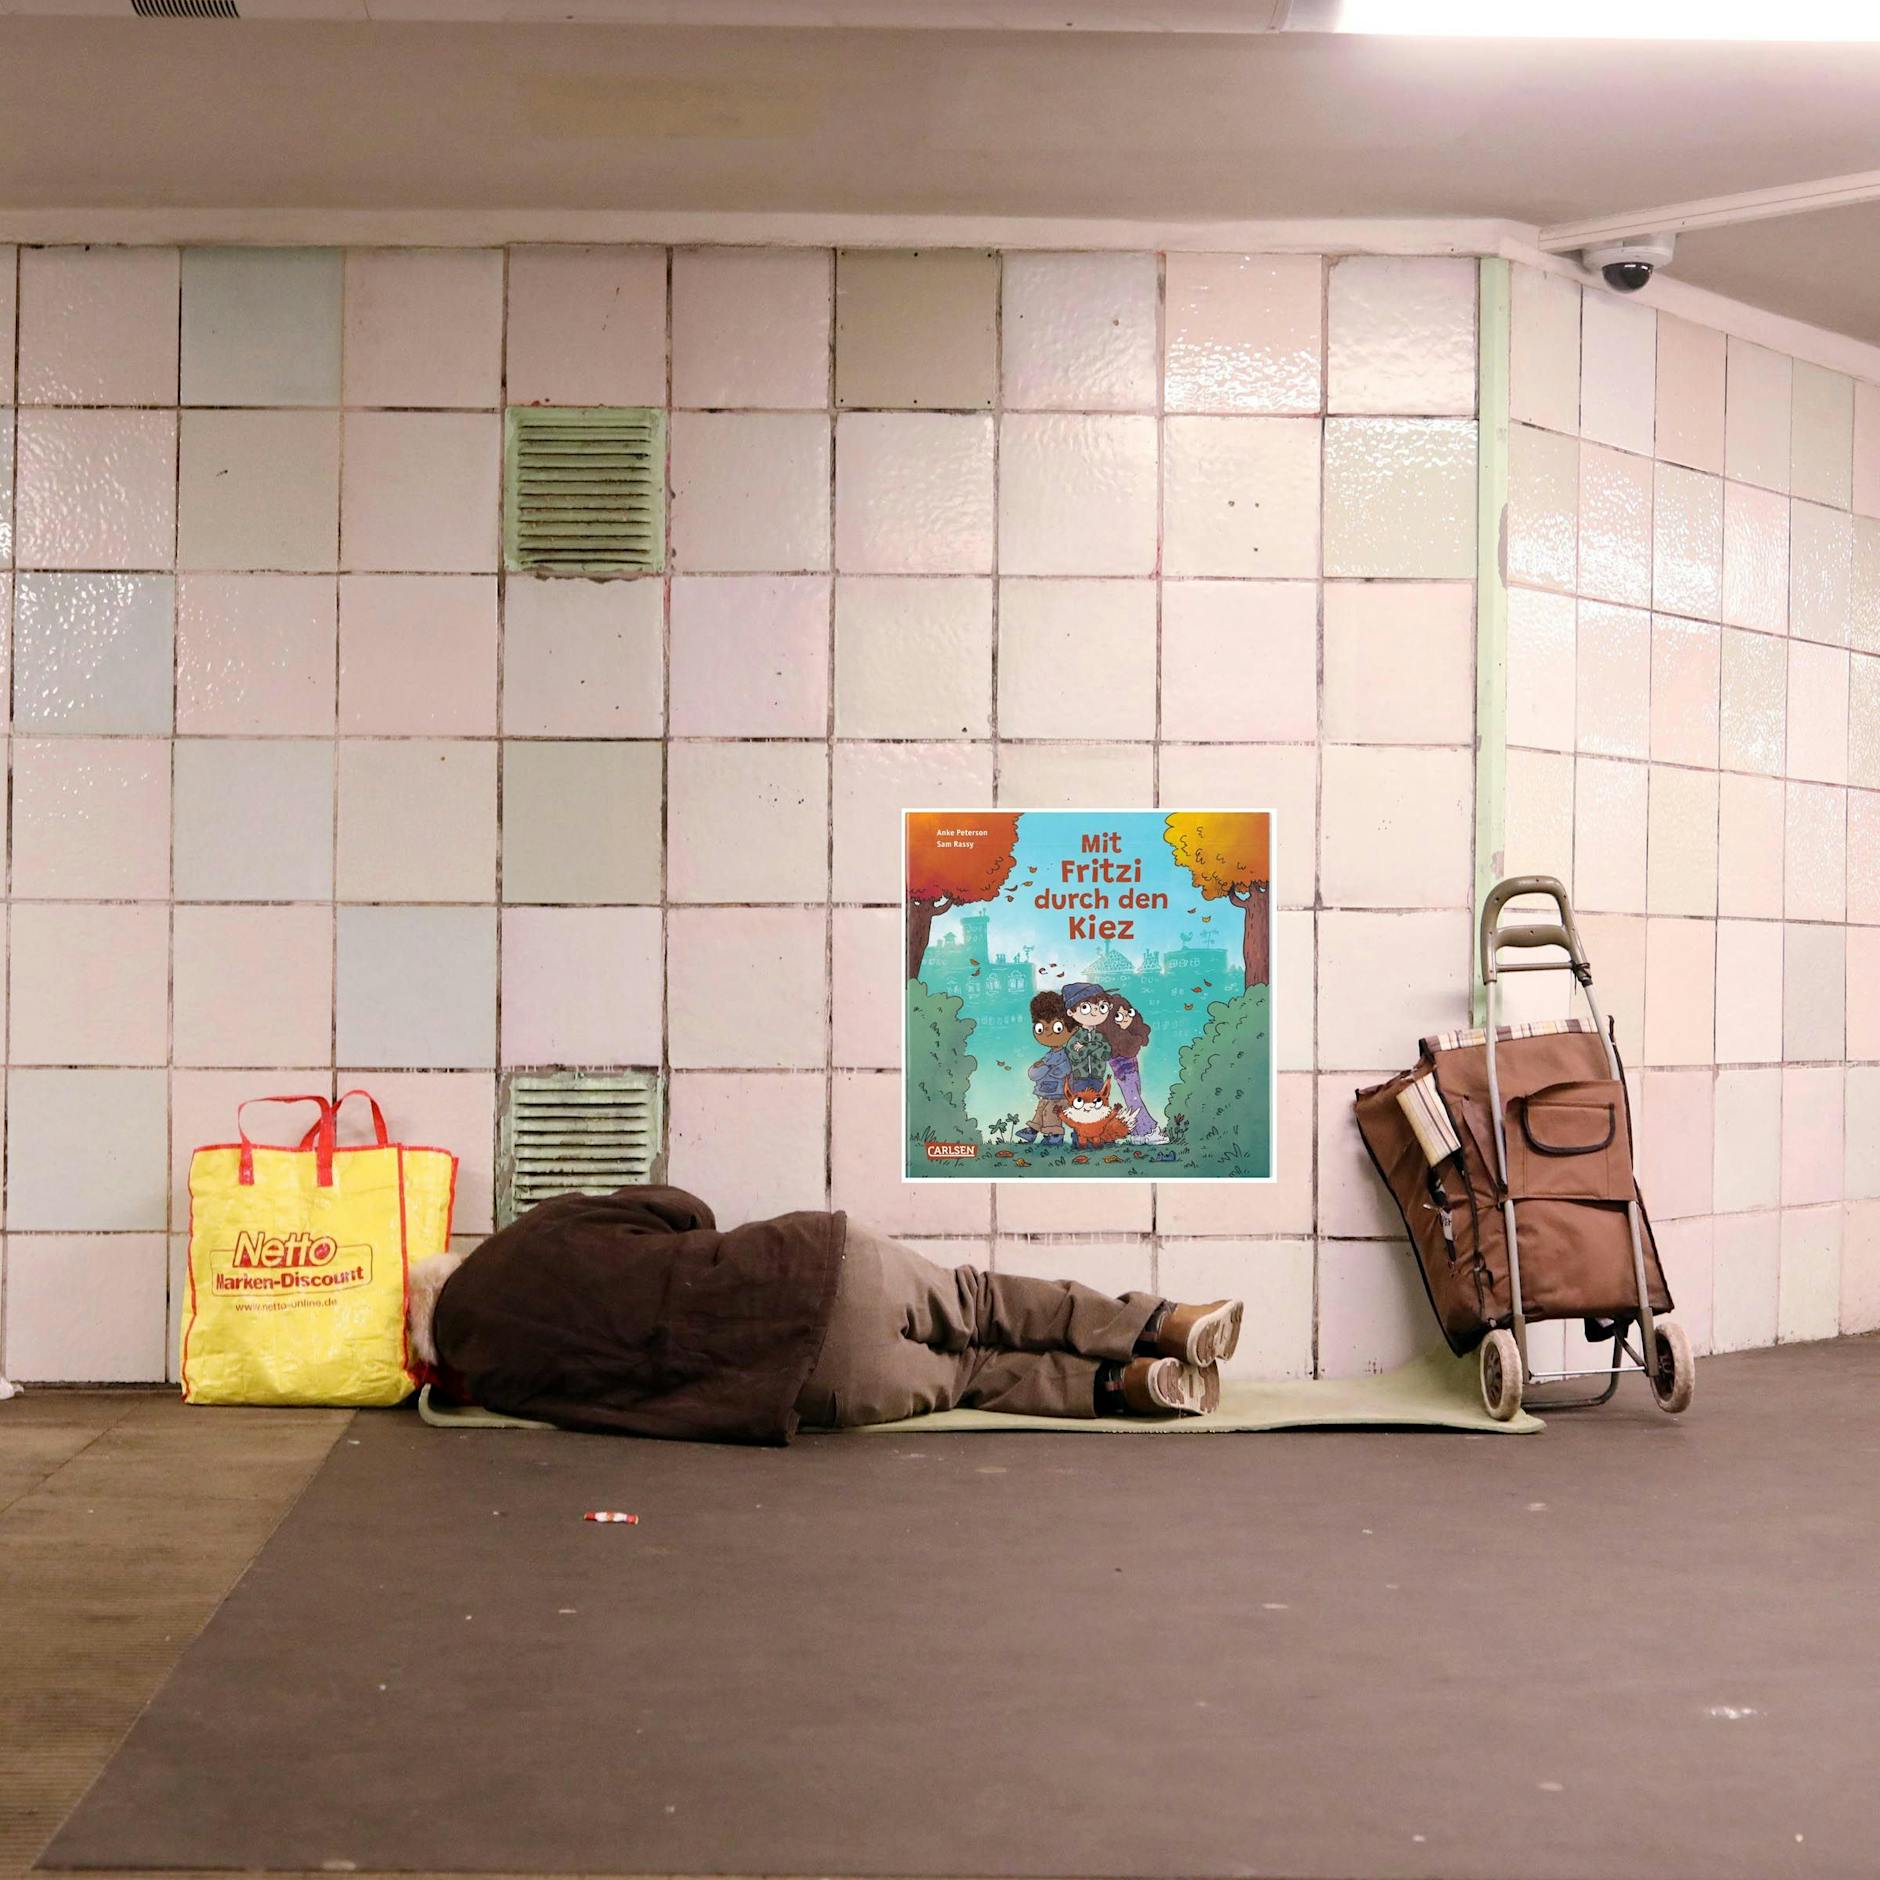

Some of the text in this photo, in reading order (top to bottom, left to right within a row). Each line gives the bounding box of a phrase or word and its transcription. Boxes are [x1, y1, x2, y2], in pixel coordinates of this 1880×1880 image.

[936, 840, 975, 849] Sam Rassy
[1081, 832, 1122, 853] Mit
[1061, 858, 1142, 883] Fritzi
[1034, 888, 1168, 909] durch den
[1068, 914, 1134, 939] Kiez
[927, 1145, 976, 1157] CARLSEN
[232, 1231, 338, 1268] Netto
[216, 1266, 364, 1290] Marken-Discount
